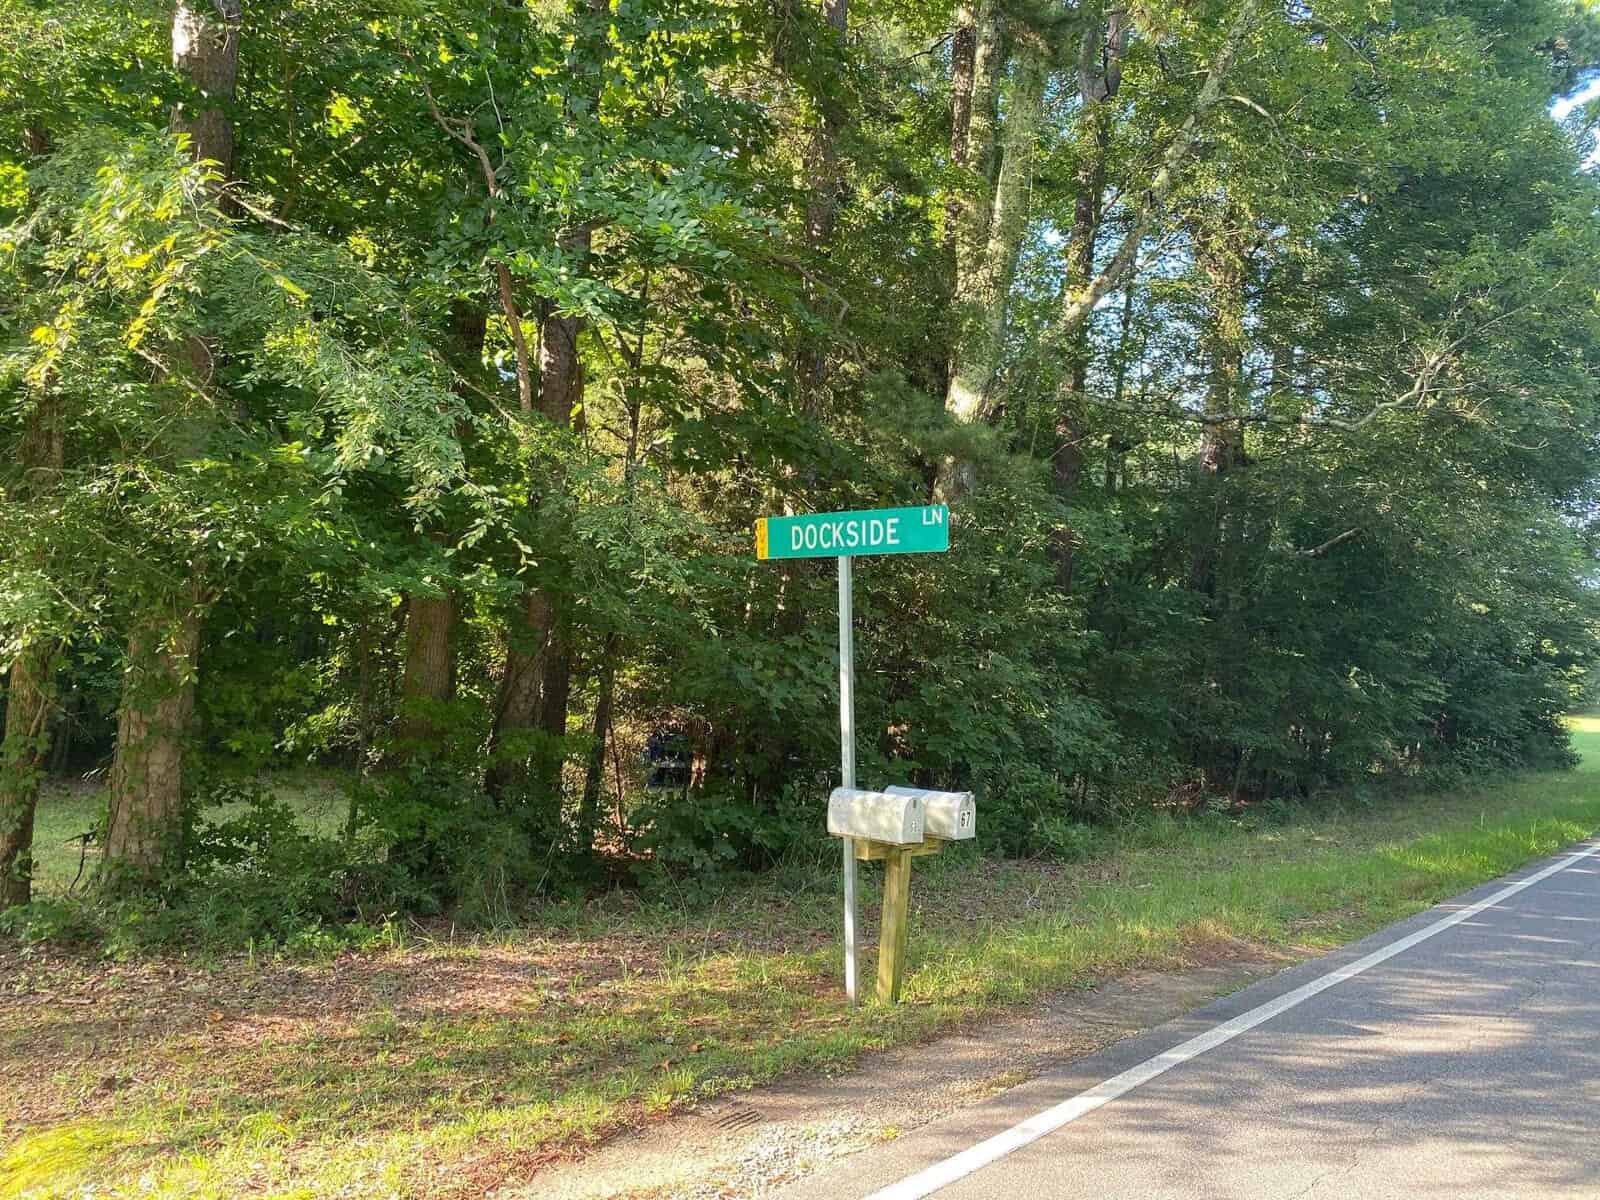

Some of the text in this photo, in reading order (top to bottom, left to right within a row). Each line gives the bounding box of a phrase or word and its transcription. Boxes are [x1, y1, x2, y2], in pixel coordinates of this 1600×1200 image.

[791, 518, 900, 551] DOCKSIDE
[922, 508, 943, 525] LN
[960, 811, 971, 827] 67
